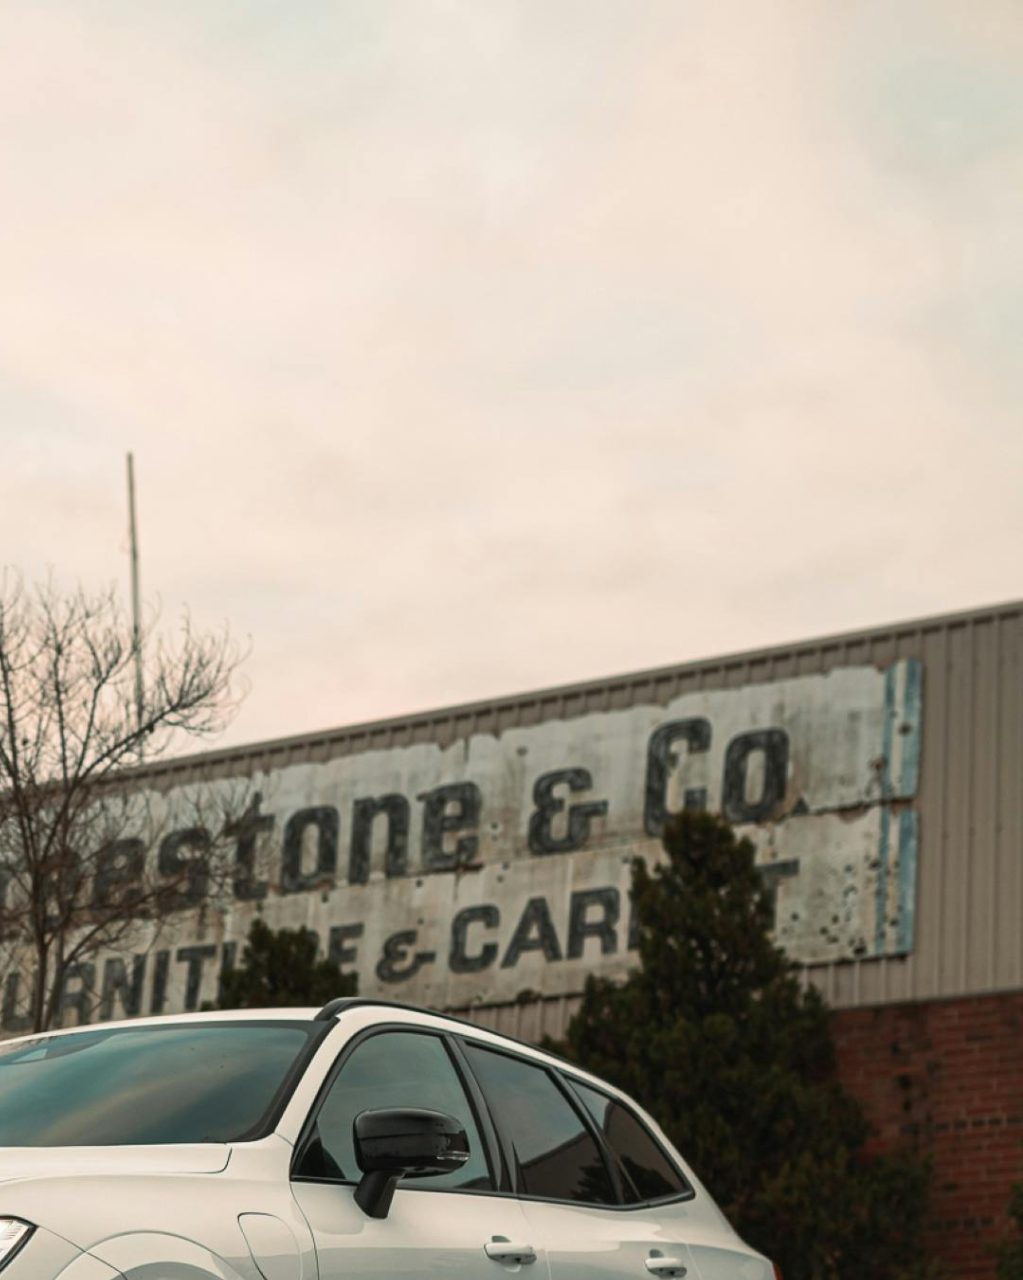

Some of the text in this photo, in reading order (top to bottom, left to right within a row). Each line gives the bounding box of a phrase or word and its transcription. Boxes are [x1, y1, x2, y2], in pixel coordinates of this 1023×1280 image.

[528, 767, 609, 856] &
[643, 716, 791, 838] Co
[376, 929, 435, 983] &
